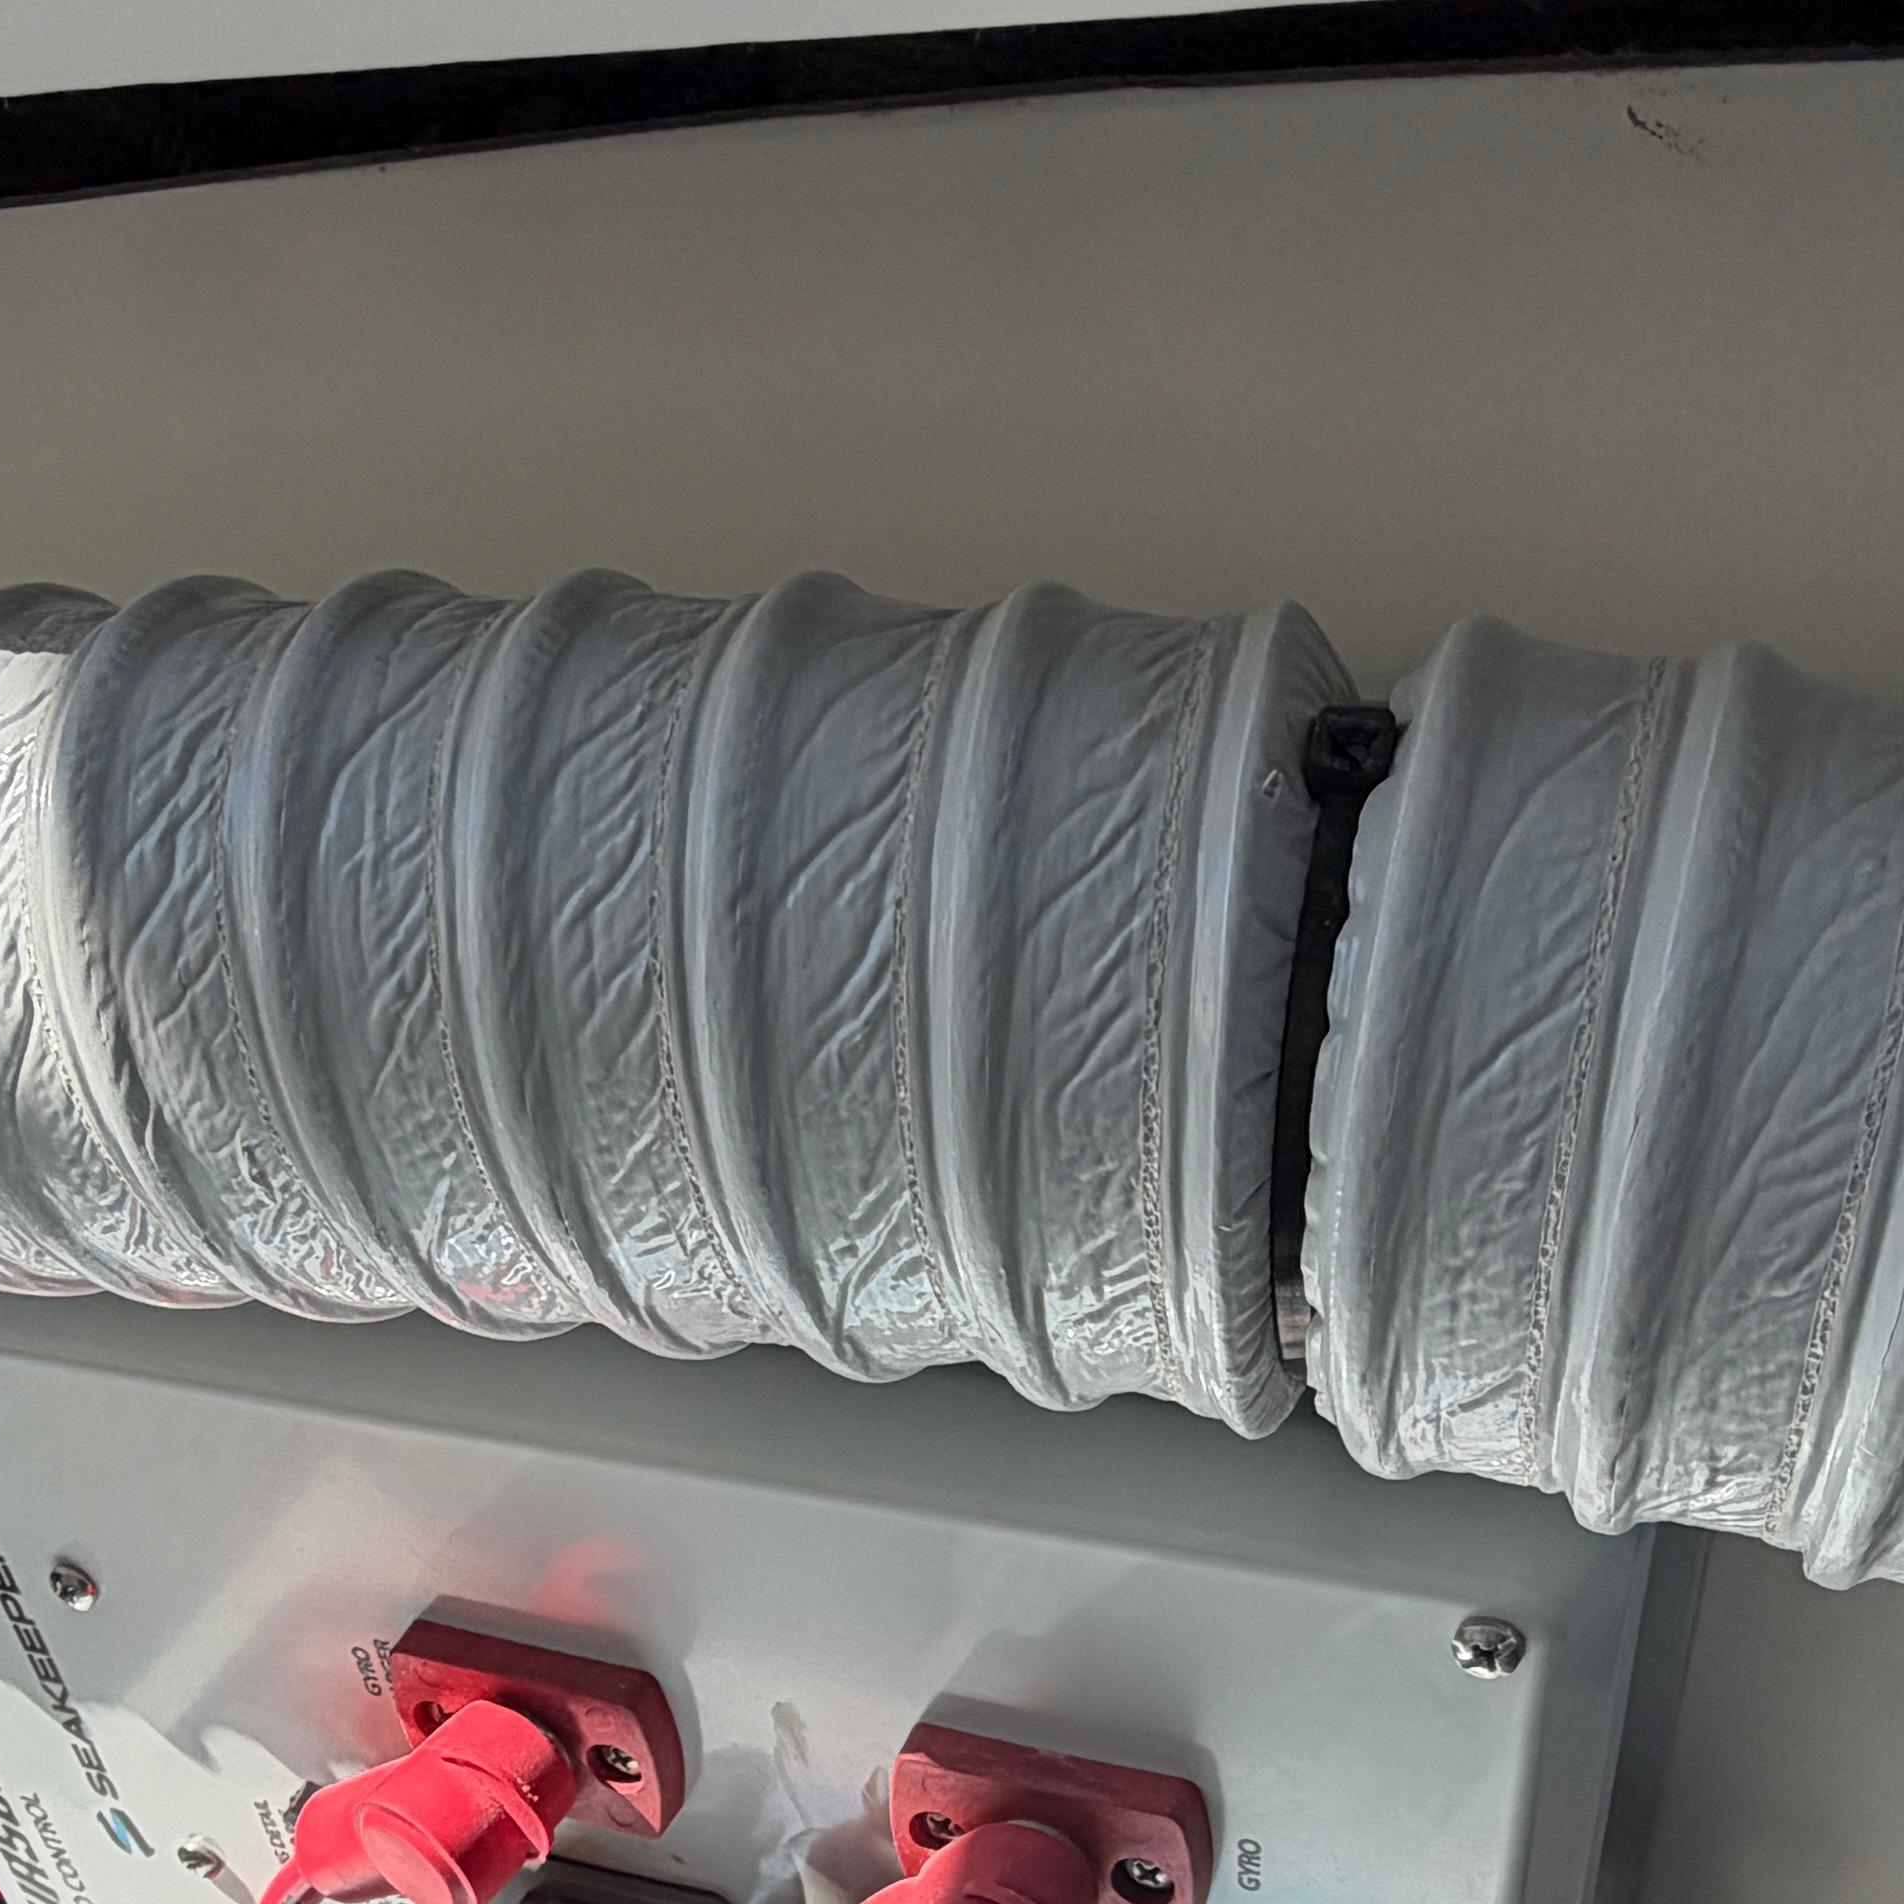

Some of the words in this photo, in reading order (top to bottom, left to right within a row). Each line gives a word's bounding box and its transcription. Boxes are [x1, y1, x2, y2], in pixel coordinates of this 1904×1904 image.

[351, 1645, 383, 1697] GYRO
[20, 1792, 86, 1902] CONTROL
[1237, 1837, 1262, 1892] GYRO
